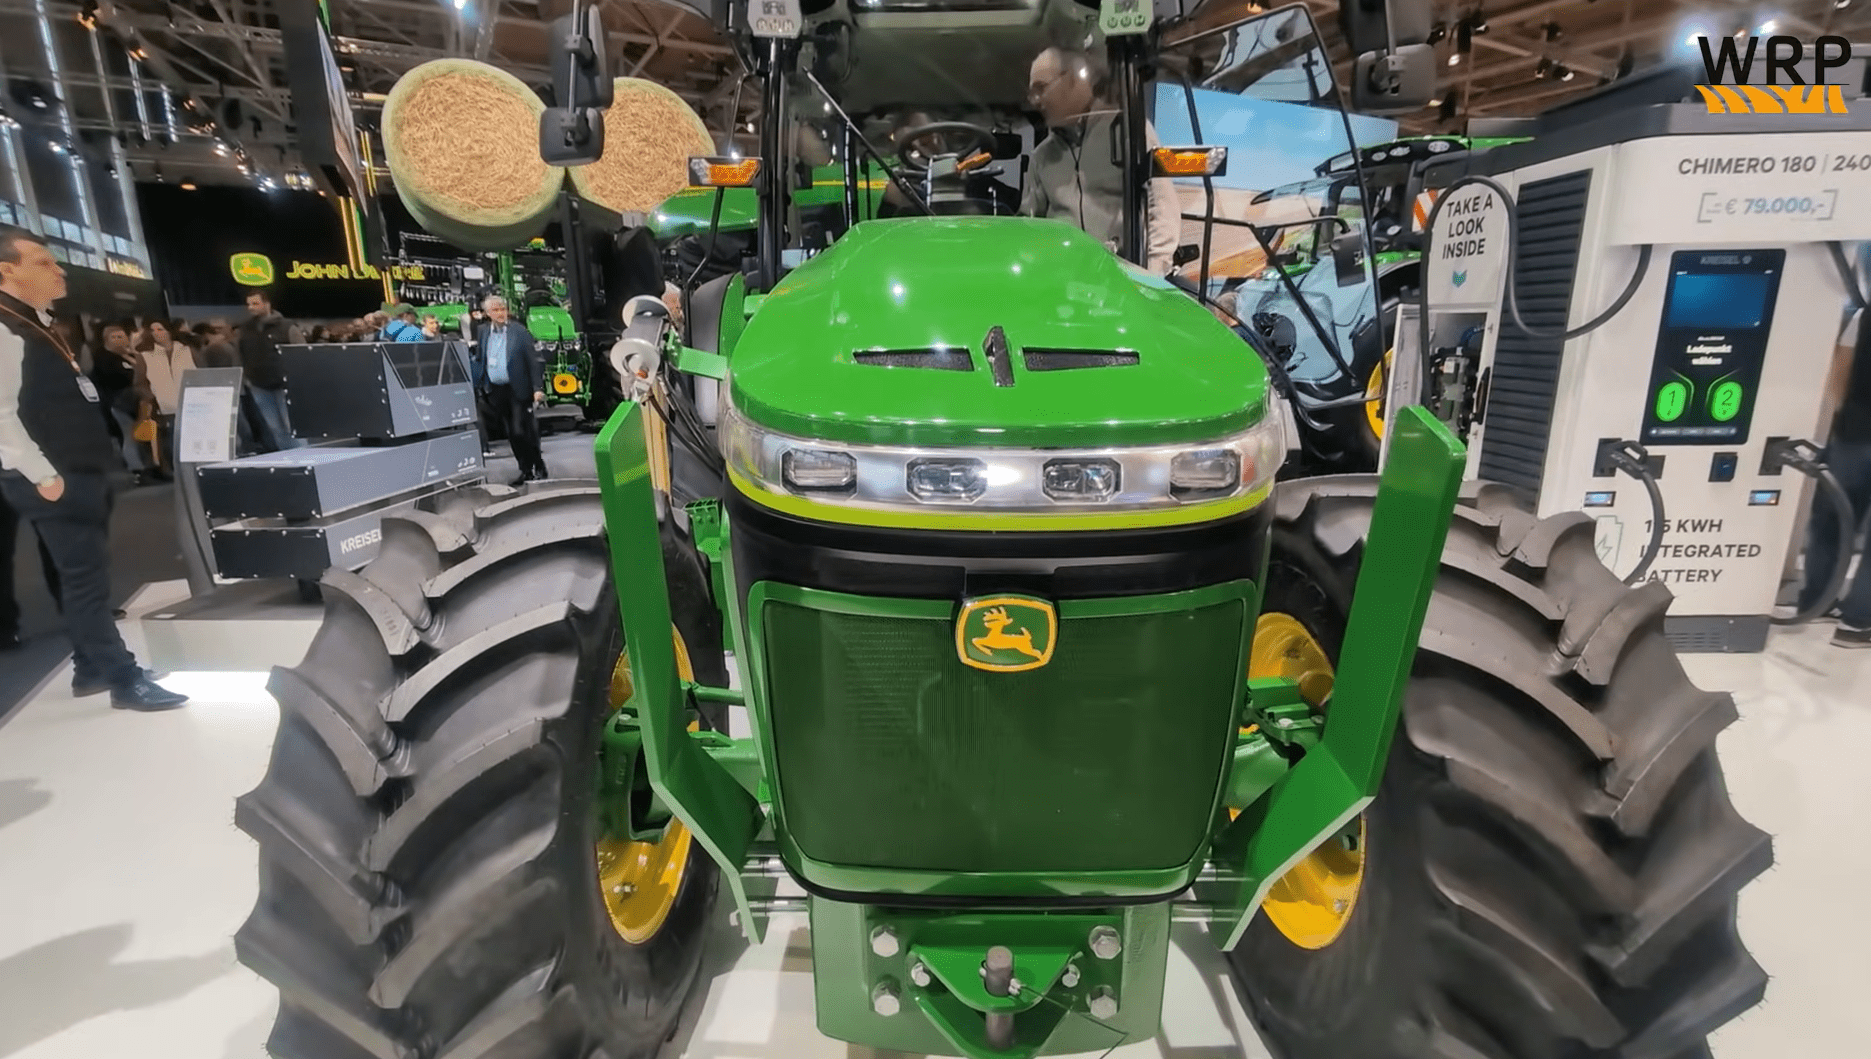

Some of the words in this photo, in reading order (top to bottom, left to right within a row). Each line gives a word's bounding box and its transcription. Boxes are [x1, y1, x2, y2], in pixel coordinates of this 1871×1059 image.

[1678, 157, 1775, 174] CHIMERO
[1781, 156, 1816, 172] 180
[1832, 154, 1871, 172] 240
[1447, 195, 1481, 218] TAKE
[1483, 193, 1493, 211] A
[1448, 216, 1485, 238] LOOK
[1442, 238, 1486, 260] INSIDE
[286, 261, 350, 279] JOHN
[1669, 389, 1676, 407] 1
[1722, 389, 1733, 406] 2
[1645, 519, 1671, 533] 15
[1676, 519, 1723, 533] KWH
[1639, 544, 1762, 558] ITEGRATED
